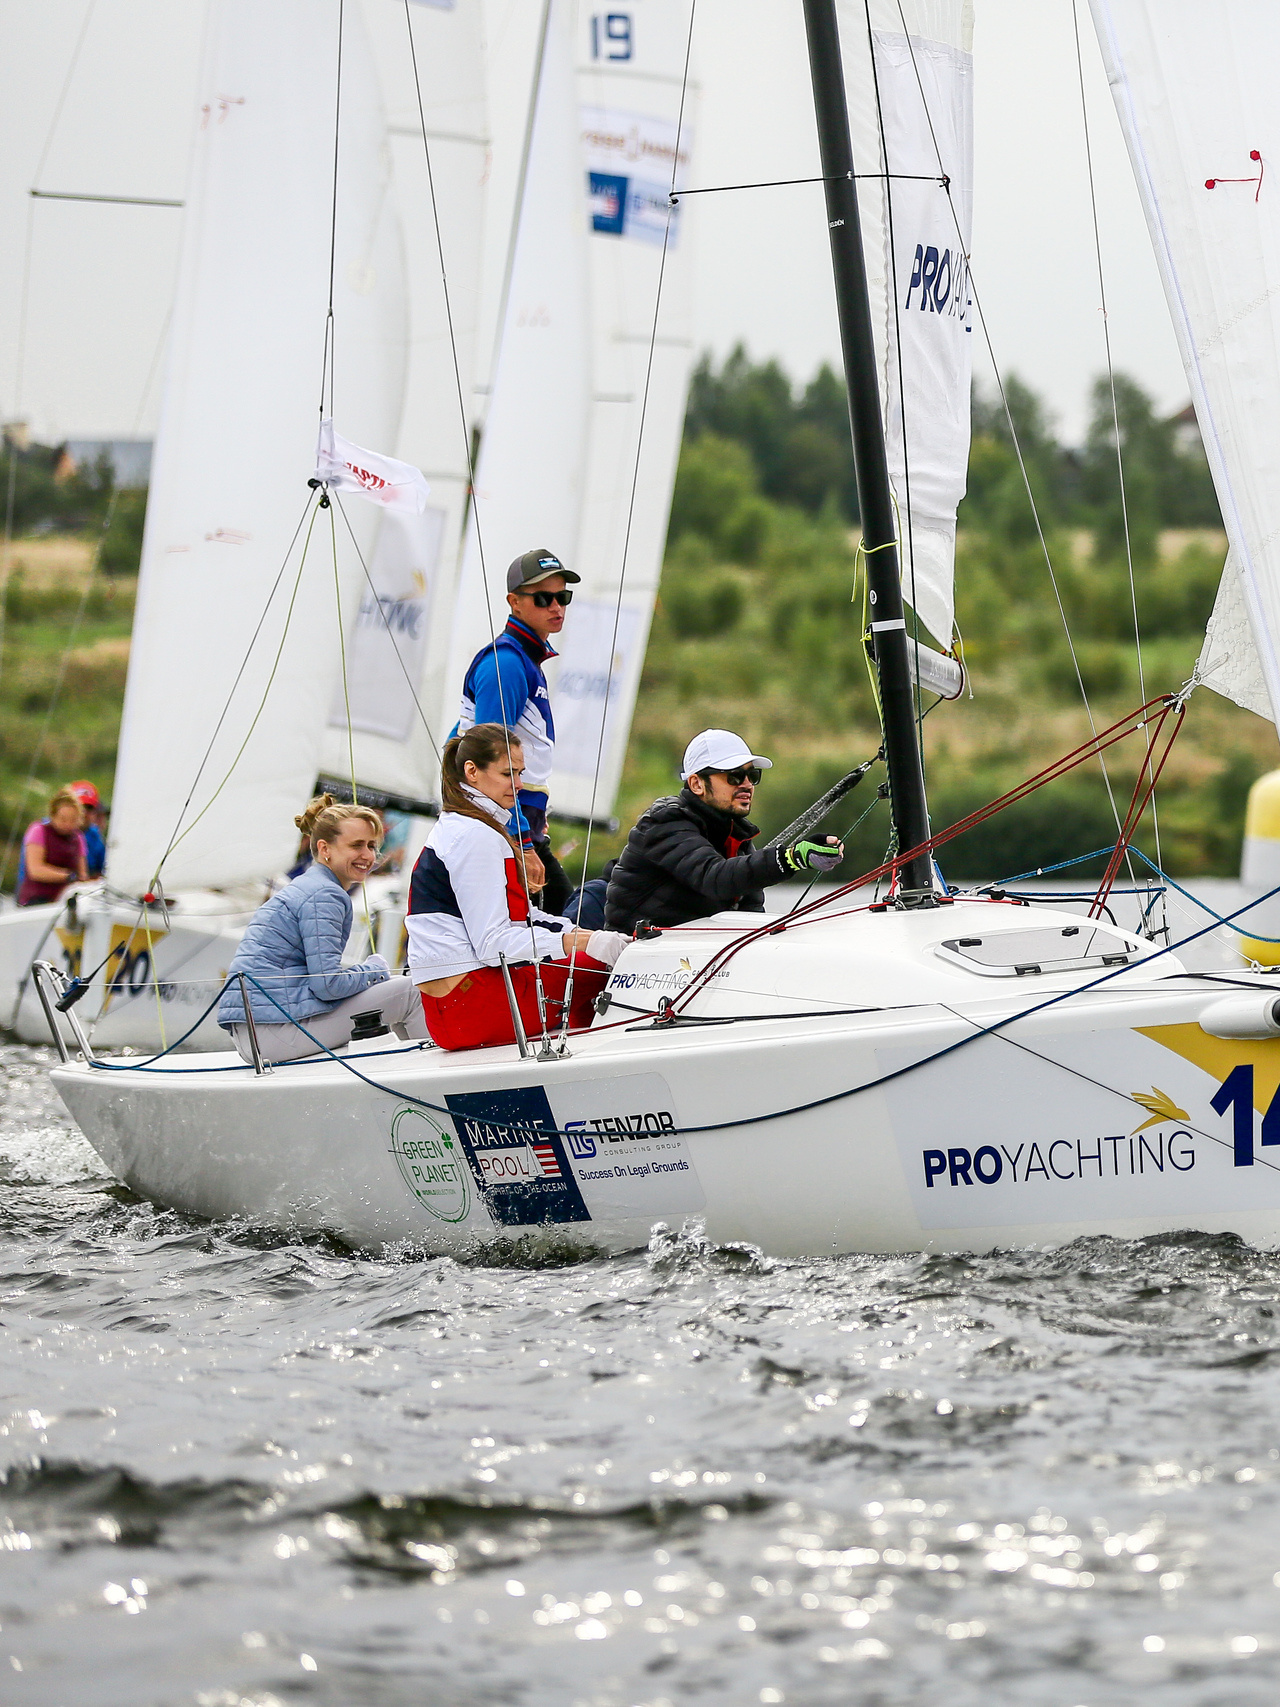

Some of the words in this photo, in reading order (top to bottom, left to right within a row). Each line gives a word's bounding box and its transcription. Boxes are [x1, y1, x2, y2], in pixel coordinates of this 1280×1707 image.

[609, 972, 689, 990] PROYACHTING
[464, 1119, 550, 1147] MARINE
[589, 1111, 678, 1144] TENZOR
[402, 1140, 445, 1160] GREEN
[604, 1145, 651, 1156] CONSULTING
[655, 1142, 682, 1151] GROUP
[922, 1130, 1196, 1188] PROYACHTING
[411, 1163, 457, 1184] PLANET
[480, 1155, 529, 1177] POOL
[578, 1166, 614, 1180] Success
[613, 1165, 628, 1178] On
[626, 1163, 652, 1178] Legal
[651, 1159, 690, 1173] Grounds
